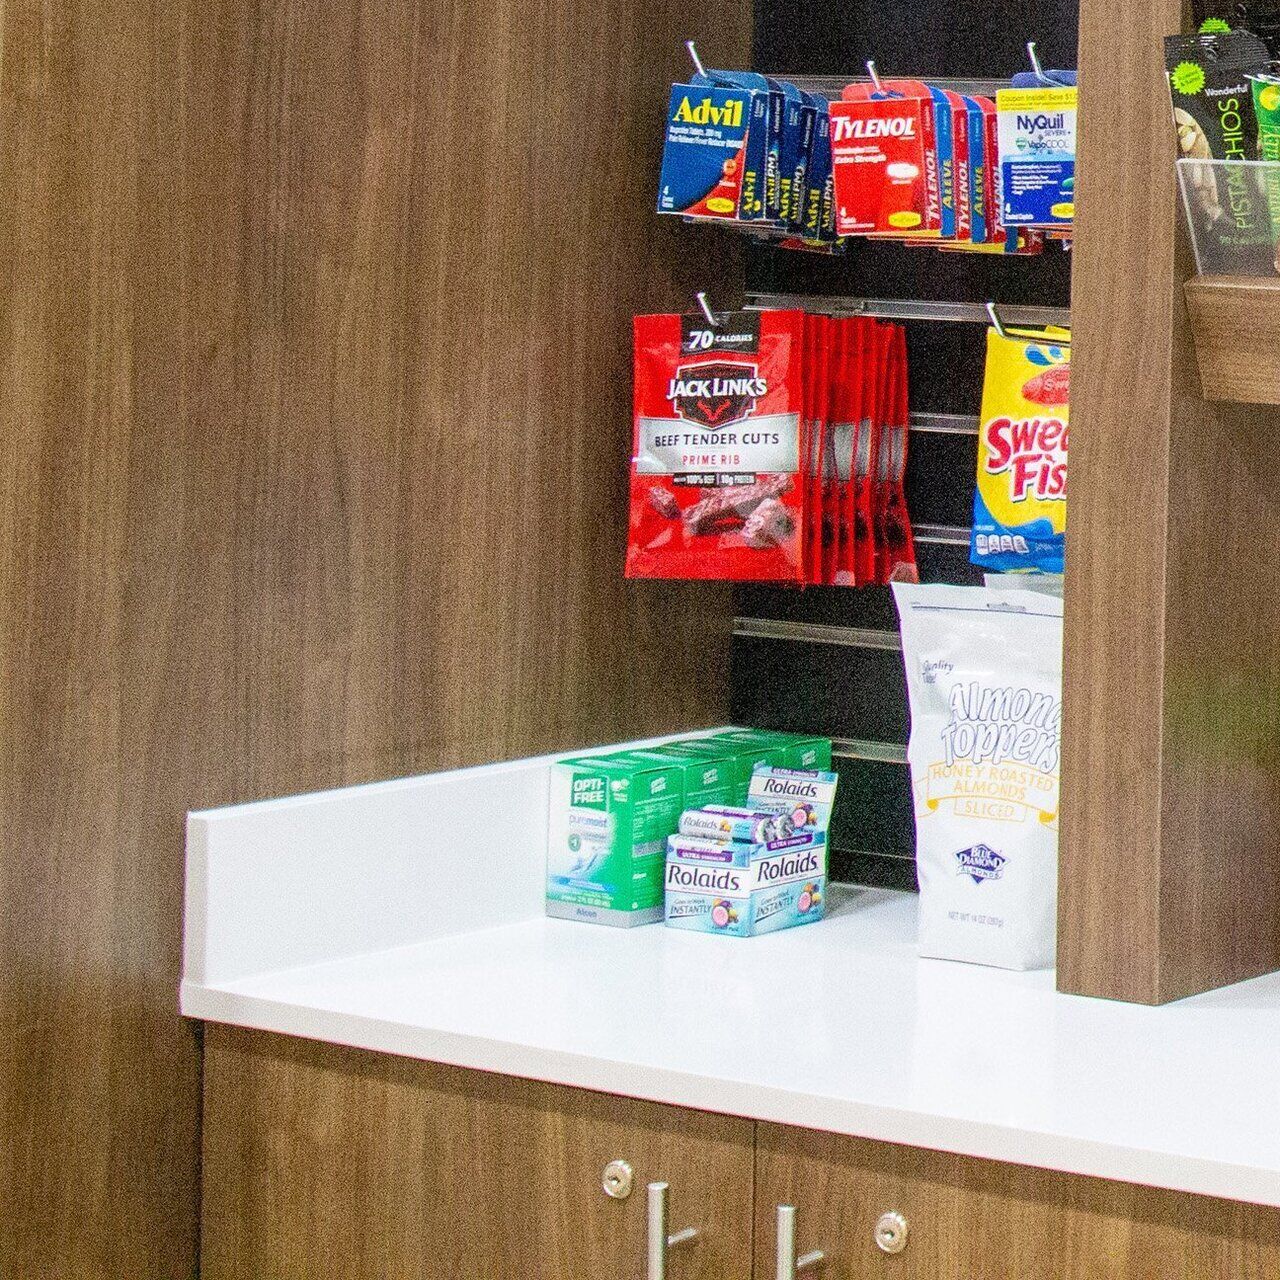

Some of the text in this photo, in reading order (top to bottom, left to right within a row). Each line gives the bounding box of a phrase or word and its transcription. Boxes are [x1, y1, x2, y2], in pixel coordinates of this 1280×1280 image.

[1204, 84, 1249, 97] Wonderful
[672, 96, 744, 127] Advil
[831, 116, 916, 142] TYLENOL
[1017, 113, 1065, 135] NyQuil
[1027, 140, 1068, 150] VapoCOOL
[925, 149, 940, 222] TYLENOL
[943, 160, 953, 209] ALEVE
[958, 160, 970, 230] TYLENOL
[689, 330, 753, 349] 70 CALORIES
[667, 377, 768, 400] JACK LINK'S
[654, 433, 780, 448] BEEF TENDER CUTS
[987, 419, 1068, 469] Swe
[682, 455, 741, 466] PRIME RIB
[941, 721, 1061, 774] Toppers
[574, 777, 605, 792] OPTI-
[764, 778, 817, 798] Rolaids
[932, 764, 1054, 792] HONEY ROASTED
[573, 791, 605, 804] FREE
[953, 778, 1027, 801] ALMONDS
[964, 800, 1015, 818] SLICED
[683, 816, 718, 830] Rolaids
[960, 854, 1006, 868] DIAMOND
[971, 846, 992, 859] BLUE
[757, 852, 818, 882] Rolaids
[668, 865, 740, 891] Rolaids
[670, 904, 712, 915] INSTANTLY
